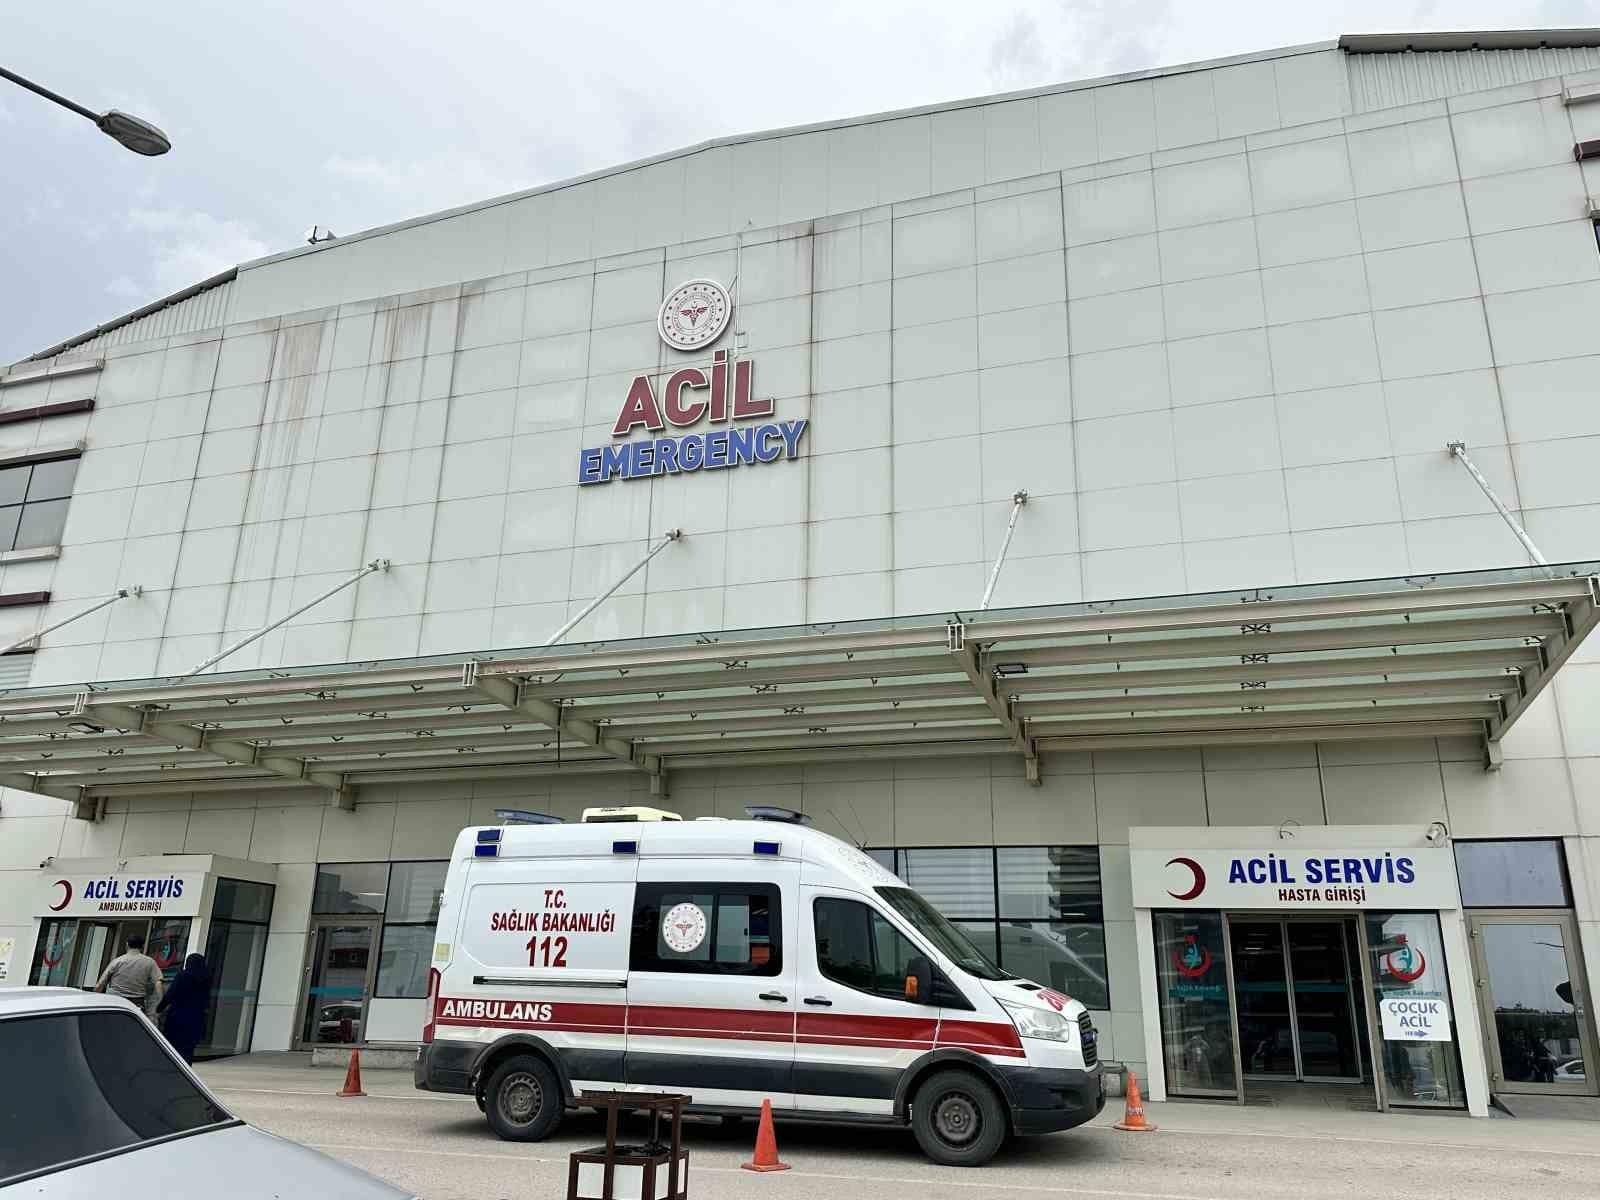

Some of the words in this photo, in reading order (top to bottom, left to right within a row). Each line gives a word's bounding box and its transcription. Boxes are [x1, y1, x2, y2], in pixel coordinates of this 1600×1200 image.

[611, 349, 775, 436] ACİL
[578, 418, 809, 485] EMERGENCY
[1229, 853, 1296, 883] ACİL
[1305, 852, 1415, 883] SERVİS
[84, 876, 119, 899] ACİL
[125, 875, 184, 898] SERVİS
[1278, 889, 1321, 901] HASTA
[1325, 886, 1366, 904] GİRİŞİ
[98, 901, 138, 912] AMBULANS
[544, 889, 567, 909] T.C.
[491, 908, 539, 932] SAĞLIK
[542, 908, 615, 932] BAKANLIĞI
[526, 935, 568, 967] 112
[442, 999, 553, 1021] AMBULANS
[1388, 1002, 1439, 1017] ÇOCUK
[1400, 1013, 1433, 1028] ACİL
